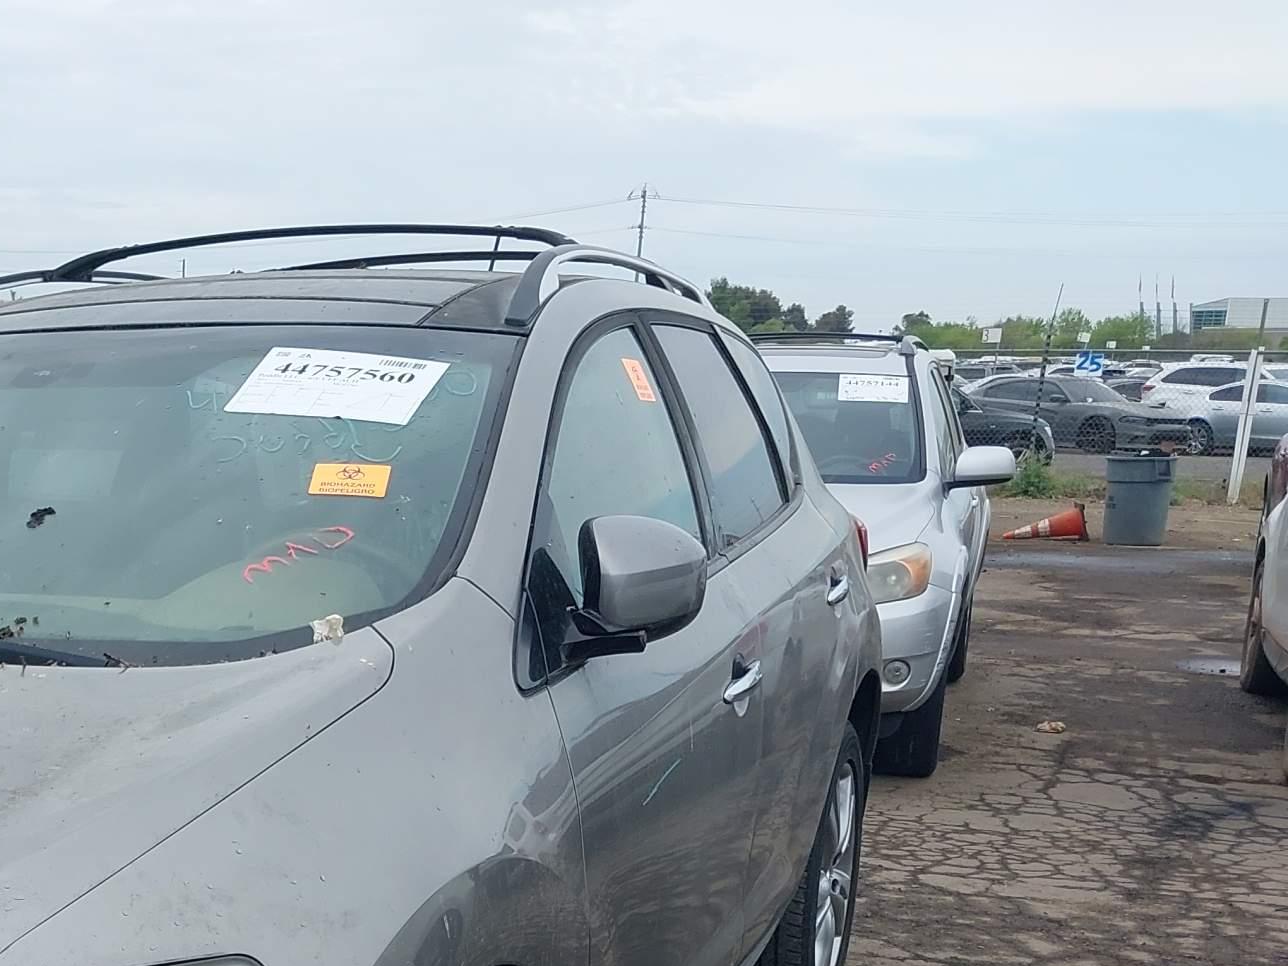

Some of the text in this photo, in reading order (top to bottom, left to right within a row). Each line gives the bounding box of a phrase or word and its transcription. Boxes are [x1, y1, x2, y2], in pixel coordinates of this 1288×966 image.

[1075, 351, 1104, 373] 25
[274, 361, 416, 385] 44757560
[318, 487, 375, 495] BIOPELIGRO
[319, 481, 376, 489] BIOHAZARD
